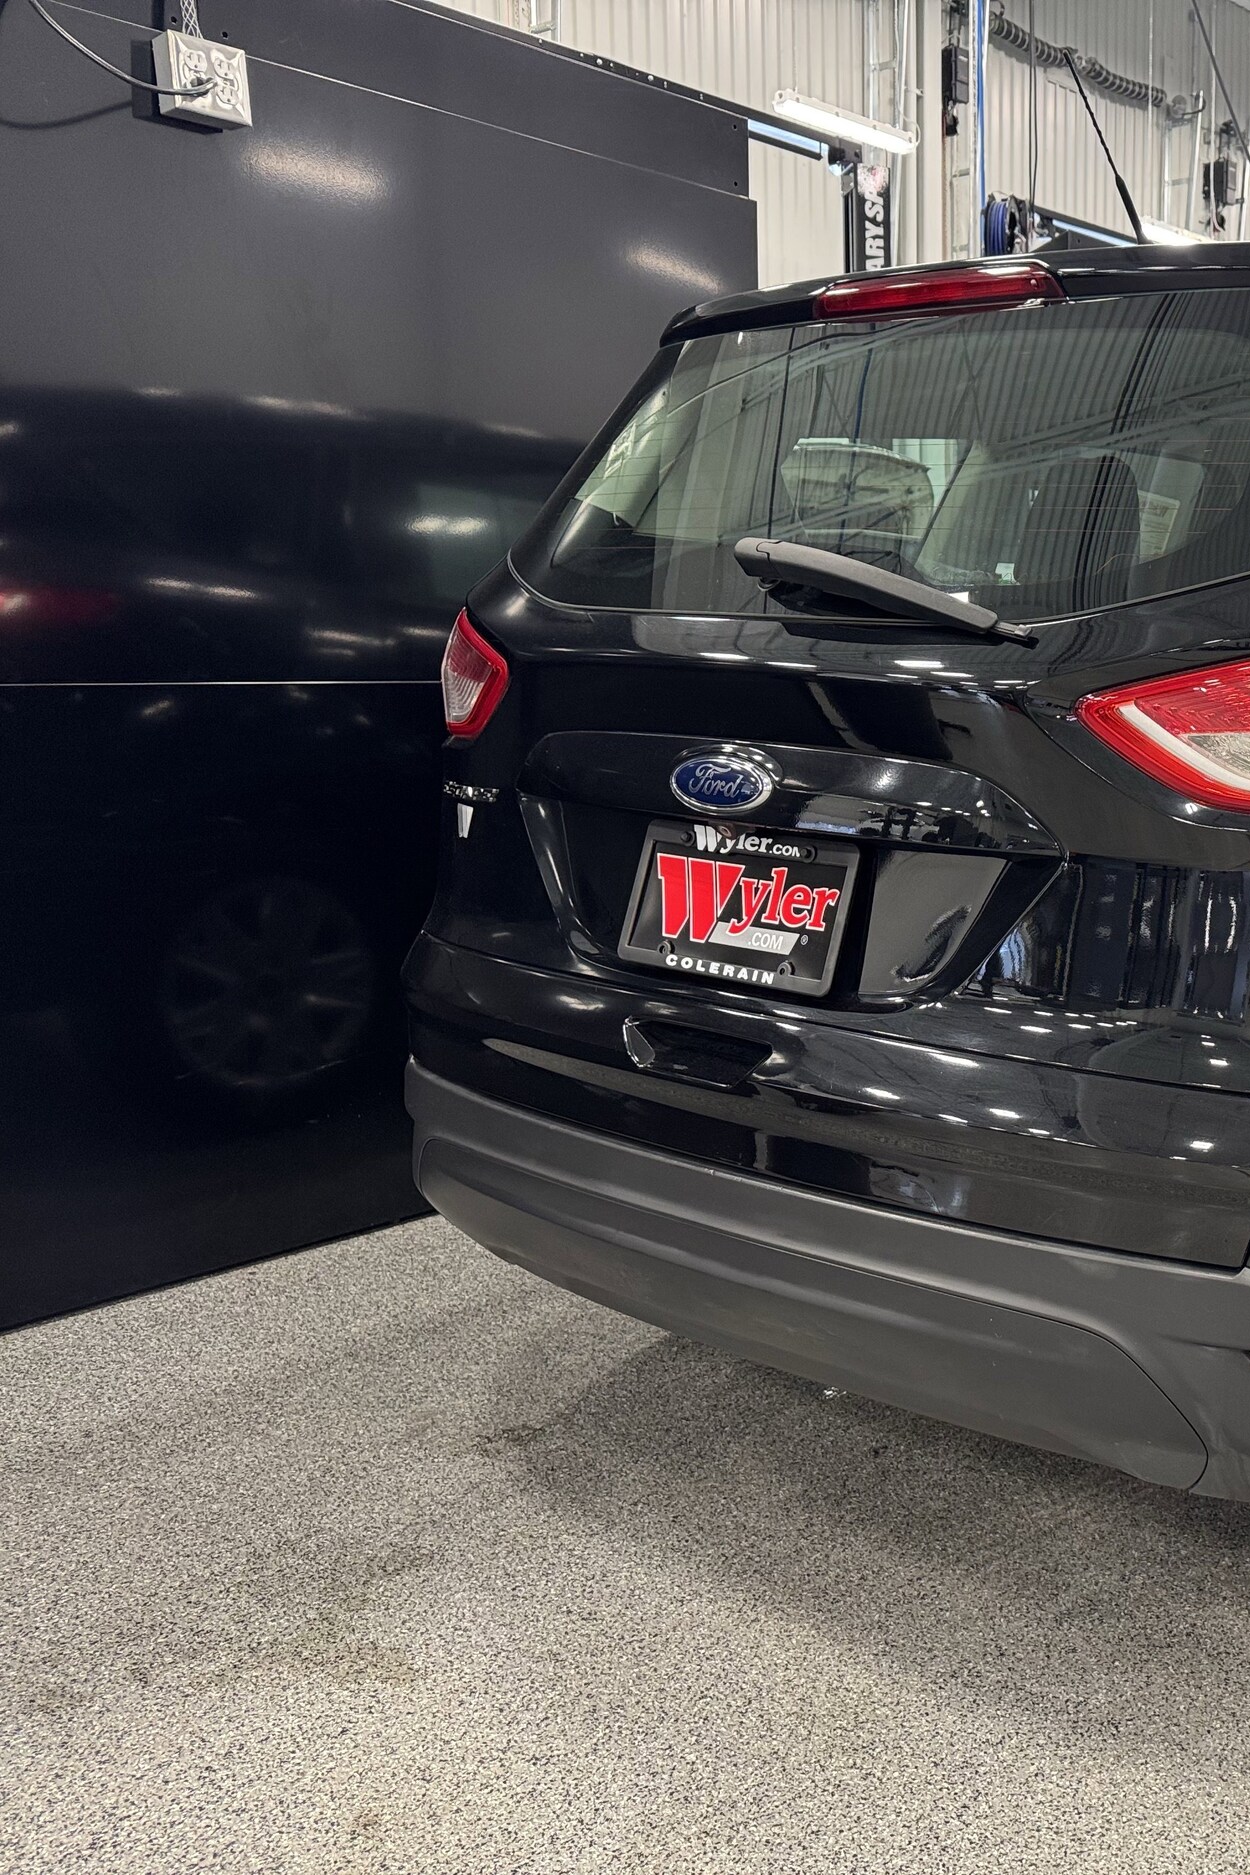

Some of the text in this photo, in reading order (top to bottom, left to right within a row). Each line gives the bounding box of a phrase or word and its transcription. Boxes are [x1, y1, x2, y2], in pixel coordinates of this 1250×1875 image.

[688, 763, 744, 798] Ford
[656, 852, 841, 944] Wyler
[665, 953, 775, 986] COLERAIN
